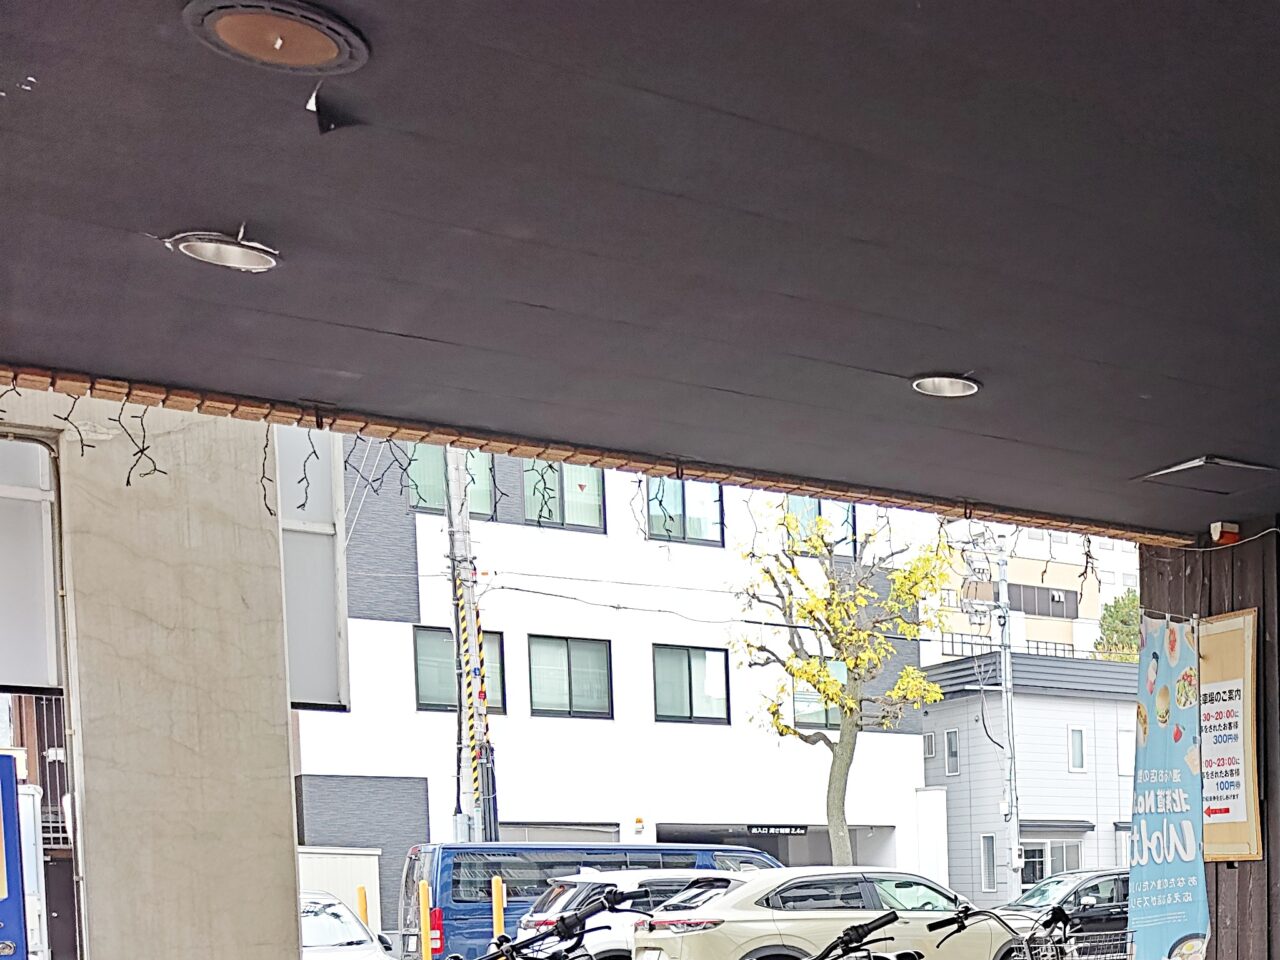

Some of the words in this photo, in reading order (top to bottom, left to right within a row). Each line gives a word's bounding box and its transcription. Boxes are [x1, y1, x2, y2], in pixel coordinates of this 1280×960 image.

[1199, 689, 1242, 706] 車場のご案内
